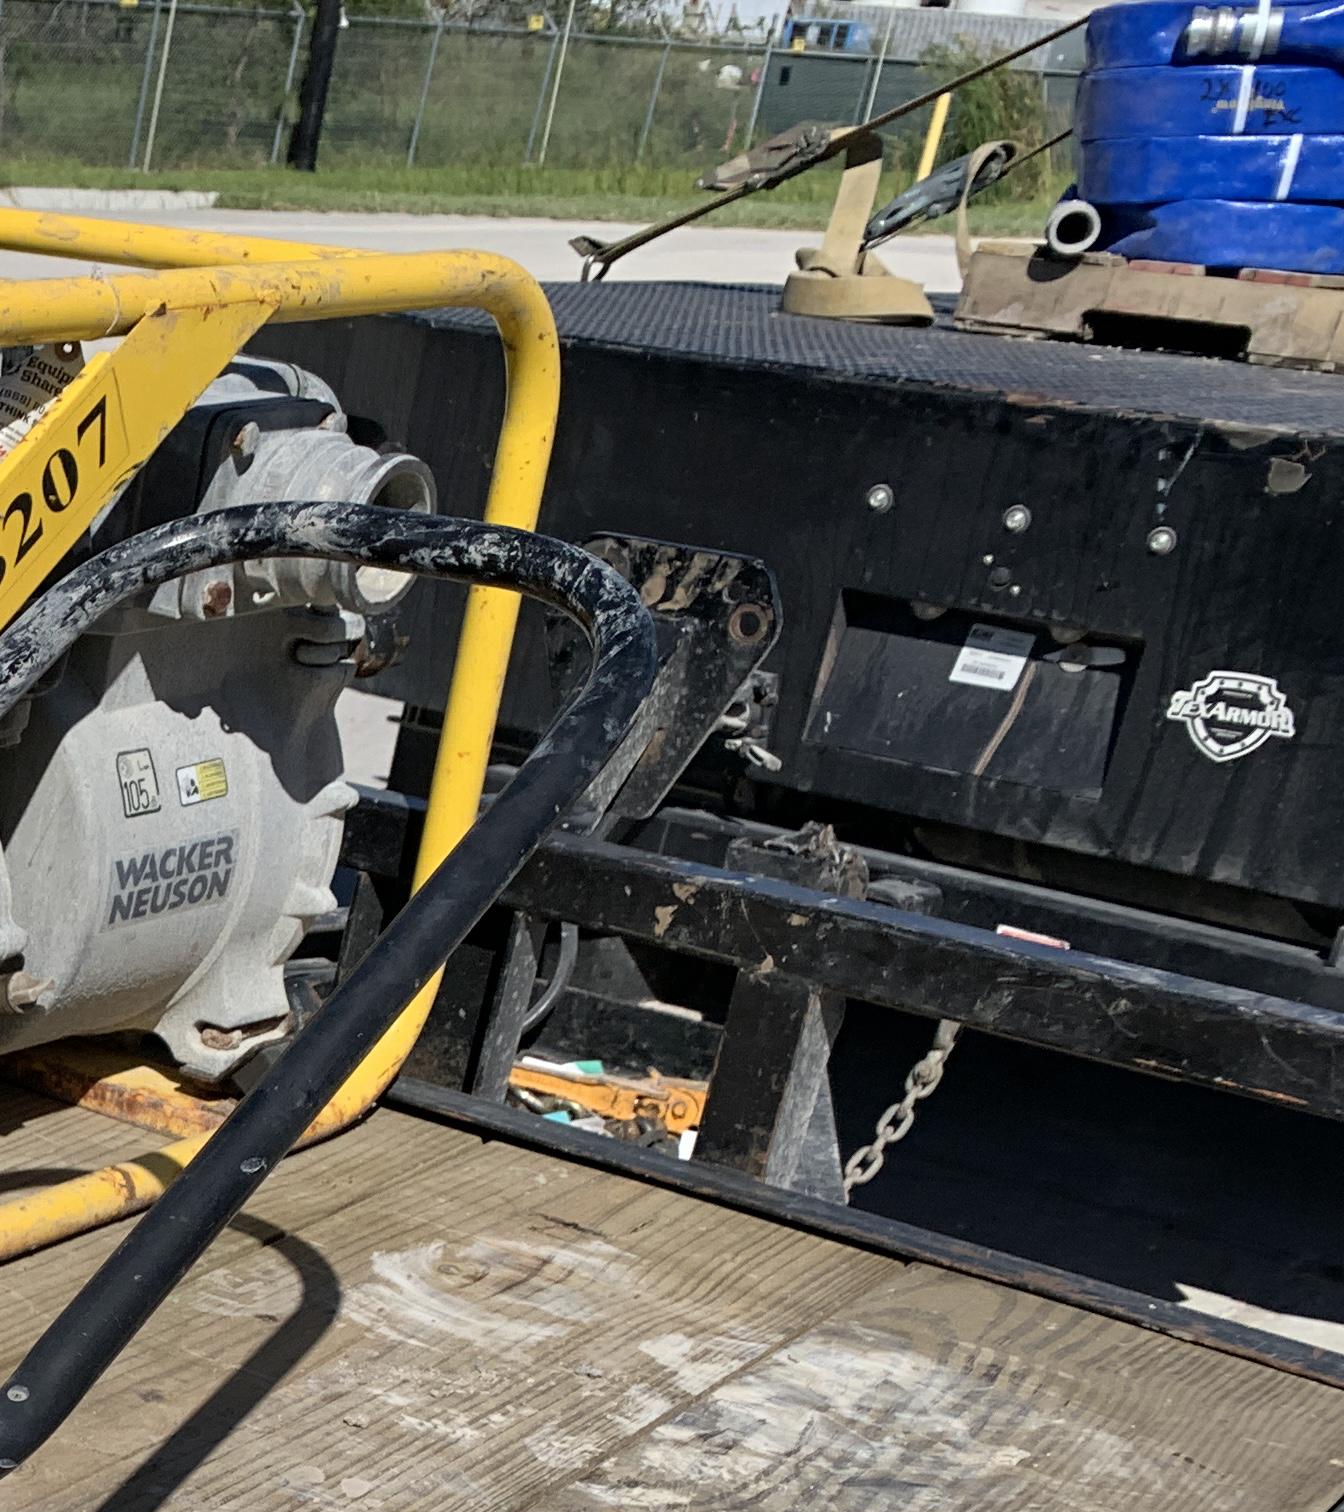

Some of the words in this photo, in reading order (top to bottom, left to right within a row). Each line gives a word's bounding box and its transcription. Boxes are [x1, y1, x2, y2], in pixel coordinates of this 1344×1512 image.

[26, 355, 77, 385] Equip
[123, 778, 150, 812] 105
[114, 835, 235, 891] WACKER
[108, 868, 232, 925] NEUSON
